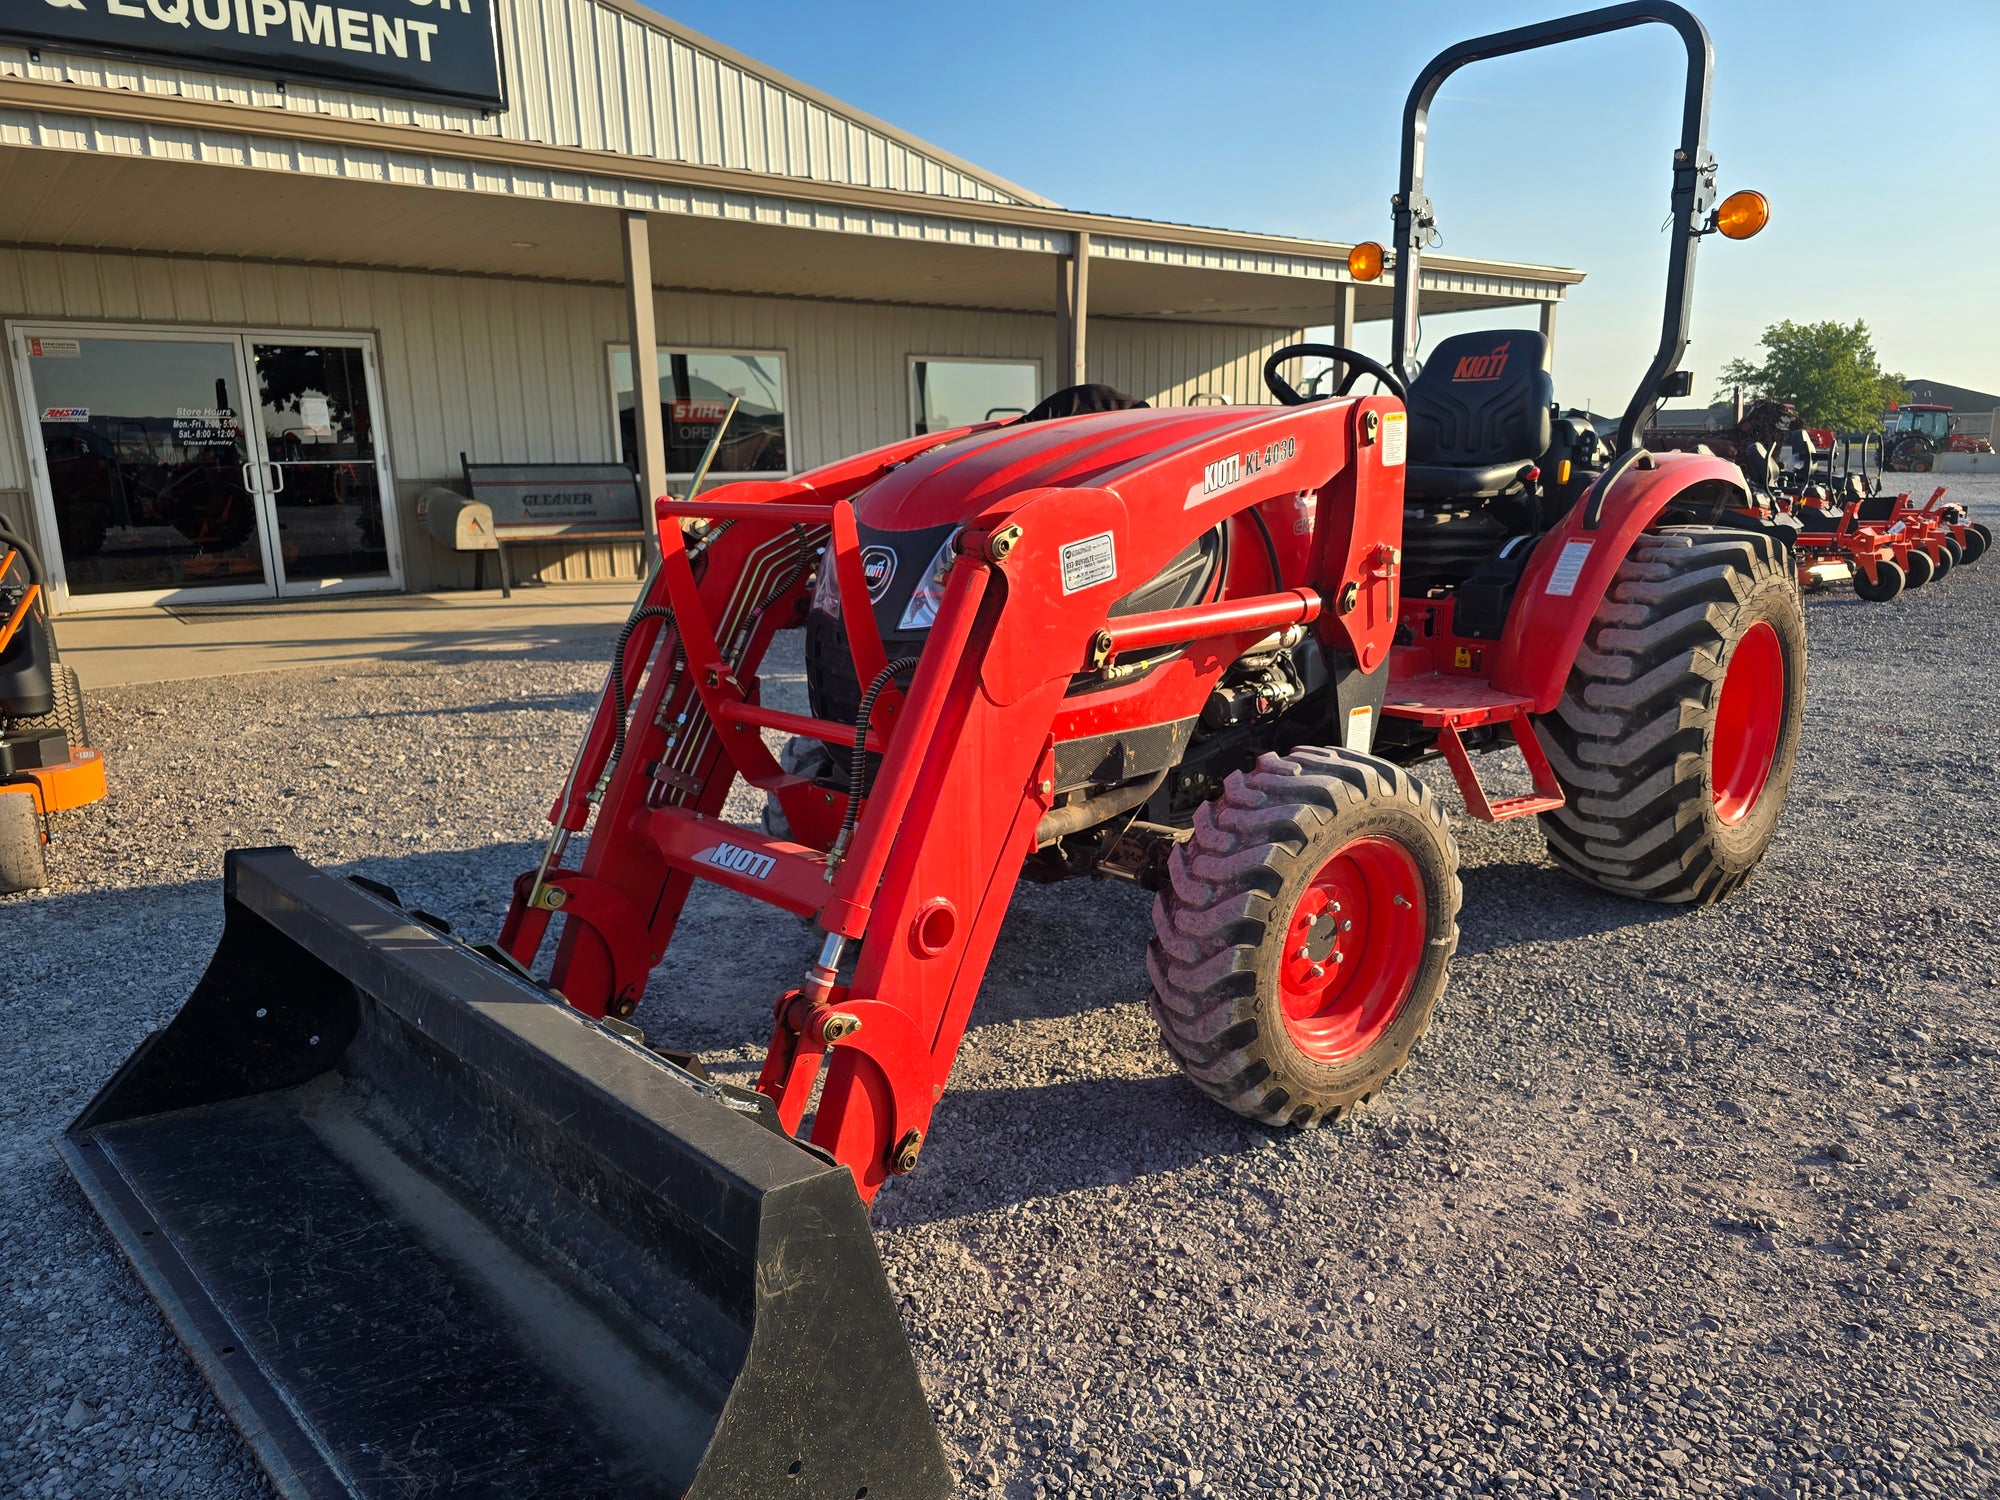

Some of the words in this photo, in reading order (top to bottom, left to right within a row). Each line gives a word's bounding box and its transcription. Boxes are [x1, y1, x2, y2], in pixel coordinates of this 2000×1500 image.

[1453, 353, 1509, 378] KIOTI
[45, 409, 88, 417] AMSOIL
[176, 407, 202, 416] Store
[204, 407, 231, 416] Hours
[674, 404, 724, 418] STIHL
[196, 429, 211, 438] 8:00
[217, 429, 235, 438] 12:00
[1203, 452, 1241, 495] KIOTI
[1263, 436, 1295, 467] 4030
[522, 493, 593, 507] GLEANER
[710, 841, 778, 880] KIOTI
